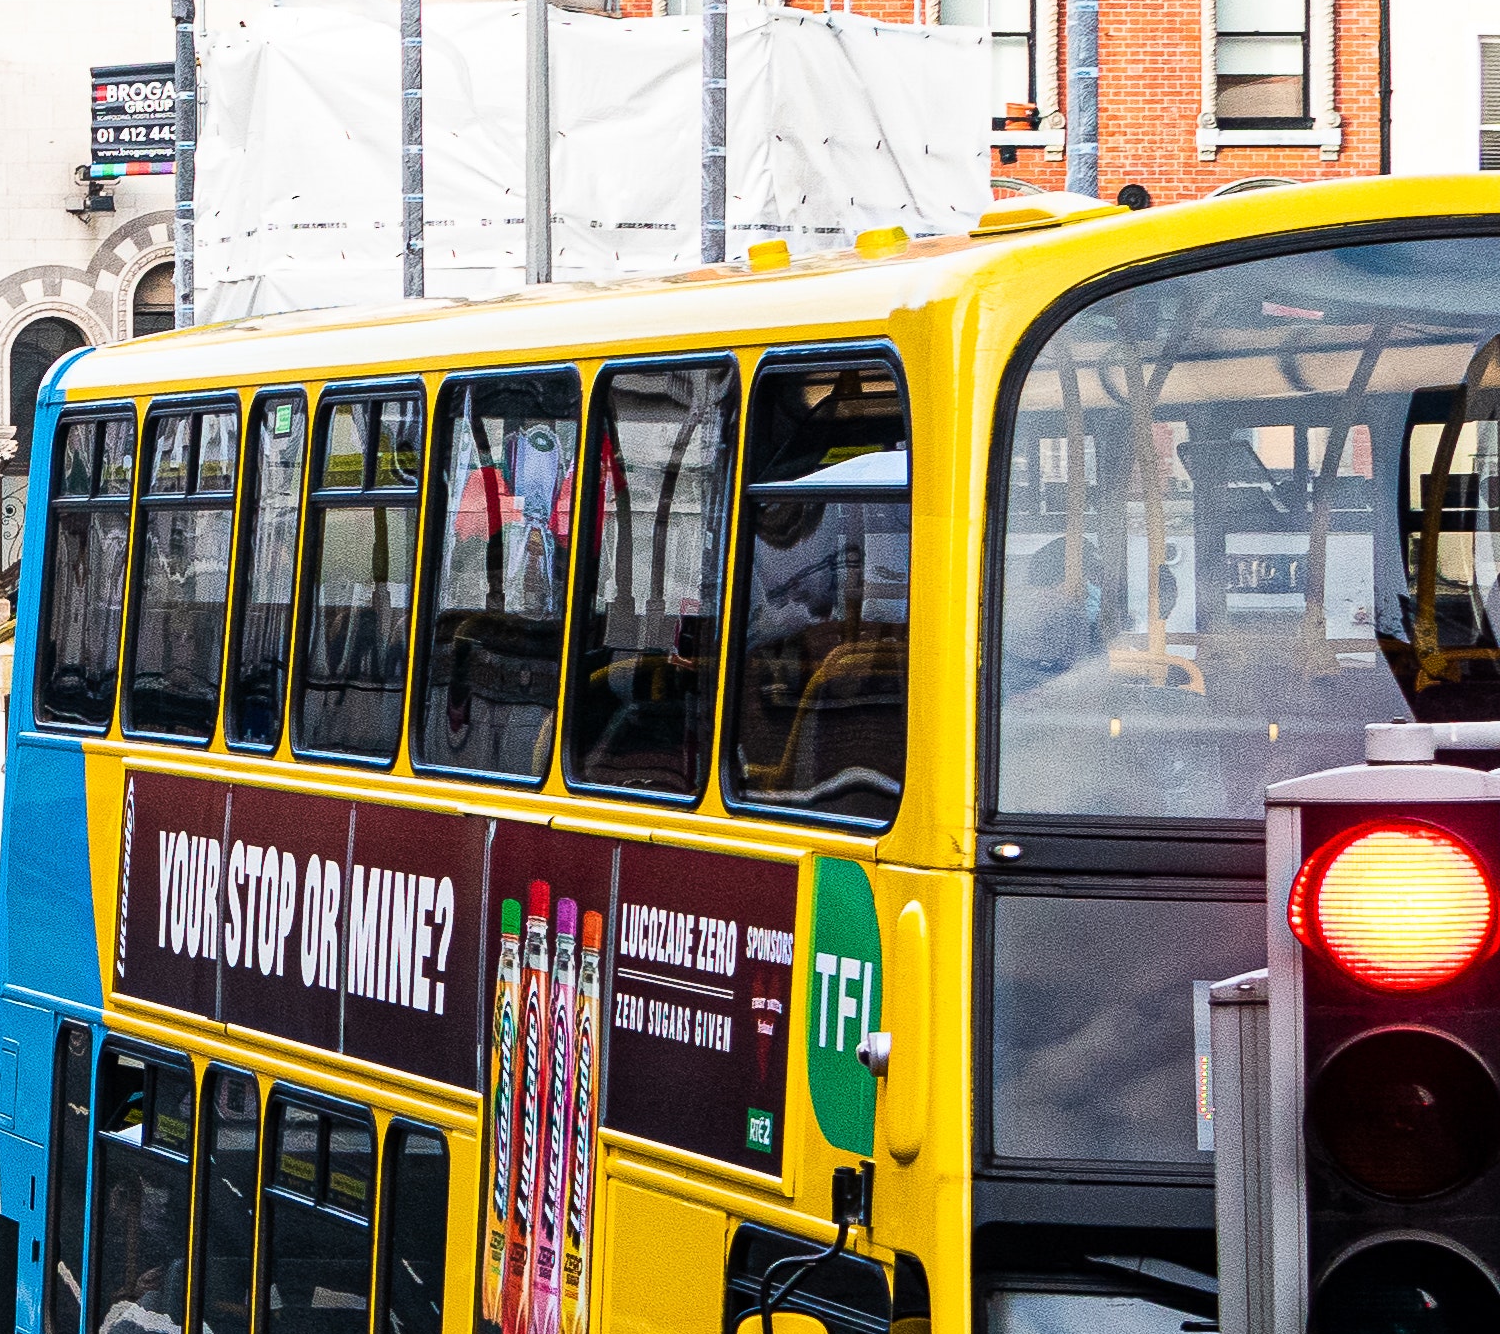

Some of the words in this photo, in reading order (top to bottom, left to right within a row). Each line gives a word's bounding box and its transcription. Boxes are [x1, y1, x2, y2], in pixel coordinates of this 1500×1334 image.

[107, 81, 177, 102] BROGA
[125, 99, 173, 113] GROUP
[97, 128, 114, 143] 01
[119, 126, 146, 141] 412
[97, 148, 176, 158] www.brogangroup.
[158, 830, 221, 960] YOUR
[225, 840, 297, 978] STOP
[301, 853, 341, 990] OR
[347, 864, 455, 1015] MINE?
[619, 902, 693, 967] LUCOZADE
[697, 916, 738, 978] ZERO
[746, 925, 794, 965] SPONSORS
[815, 952, 873, 1053] TFI
[615, 993, 644, 1031] ZERO
[648, 1001, 691, 1044] SUGARS
[695, 1011, 733, 1053] GIVEN
